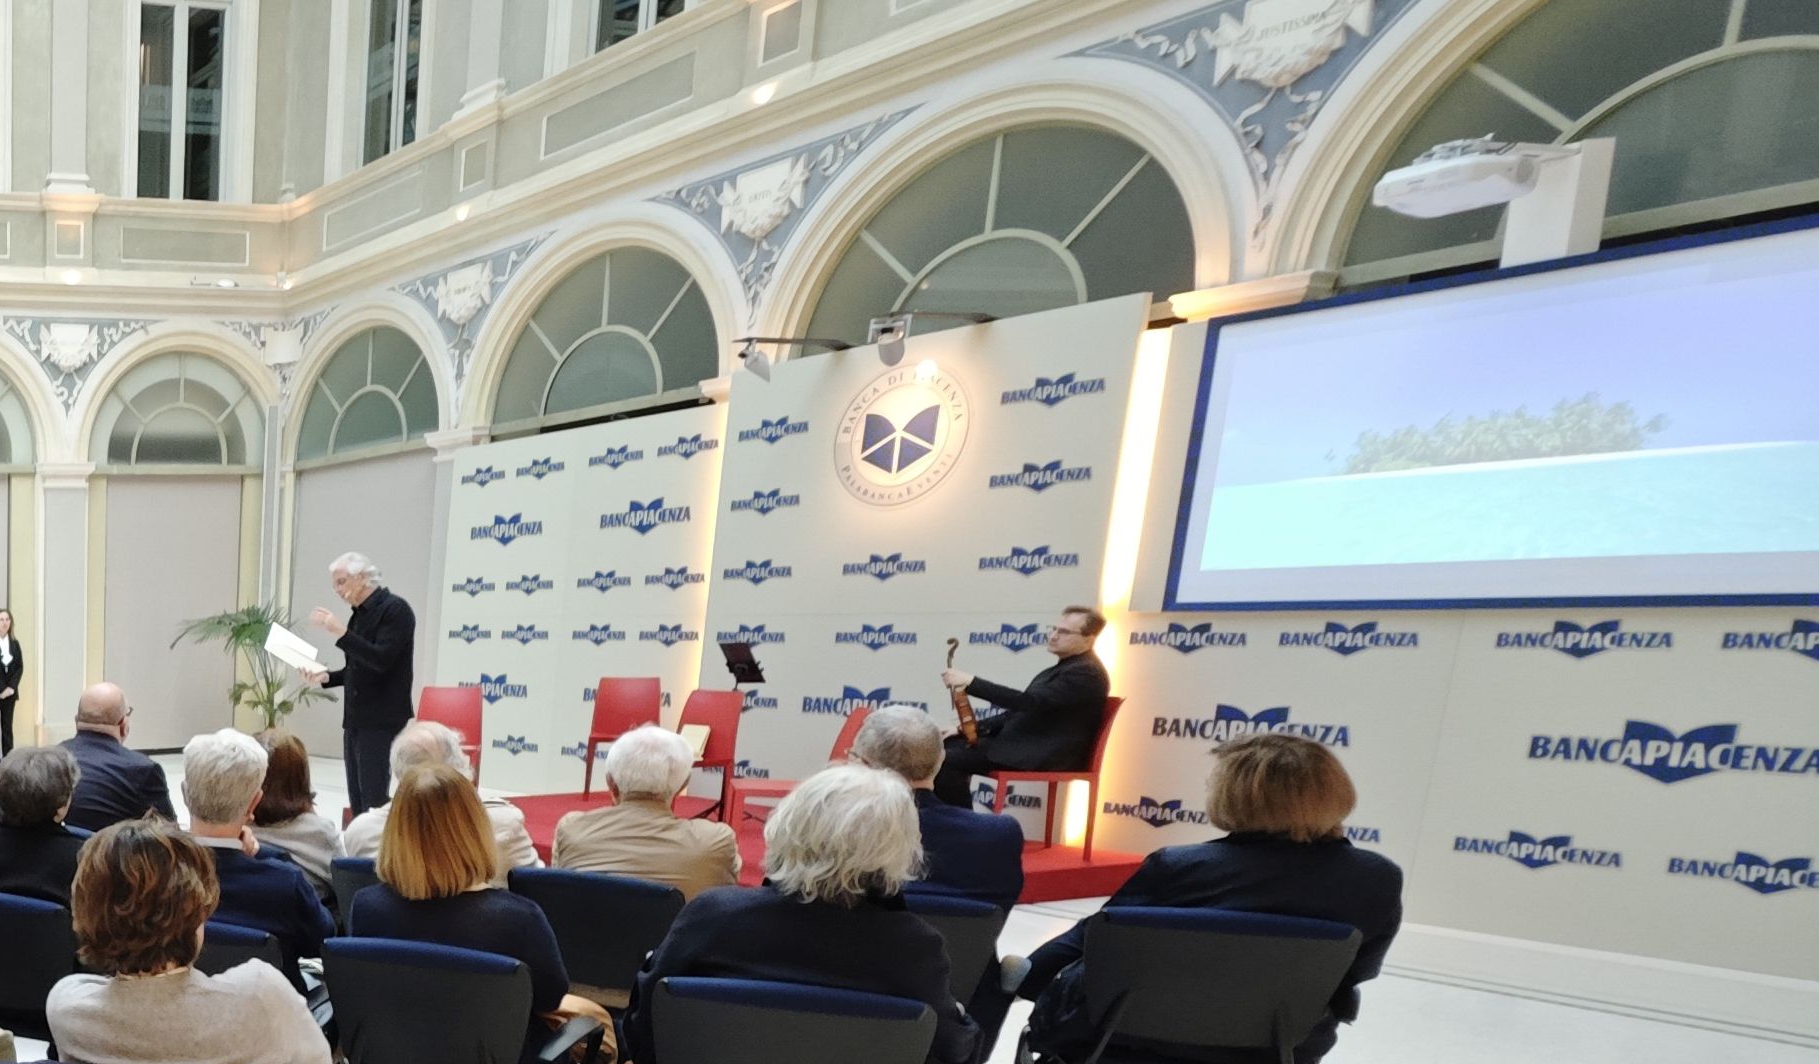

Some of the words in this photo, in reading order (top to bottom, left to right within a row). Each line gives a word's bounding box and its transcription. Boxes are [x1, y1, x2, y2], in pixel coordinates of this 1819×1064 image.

[1001, 378, 1106, 405] BANCAPIACENZA
[989, 465, 1092, 489] BANCAPIACENZA
[600, 506, 691, 529] BANCAPIACENZA
[470, 520, 542, 540] BANCAPIACENZA
[842, 560, 926, 576] BANCAPIACENZA
[979, 552, 1078, 570] BANCAPIACENZA
[835, 631, 917, 645] BANCAPIACENZA
[1130, 631, 1246, 646] BANCAPIACENZA
[1279, 631, 1419, 647] BANCAPIACENZA
[1495, 631, 1673, 649] BANCAPIACENZA
[1103, 802, 1209, 825] BANCAPIACENZ
[1454, 836, 1621, 868] BANCAPIACENZA
